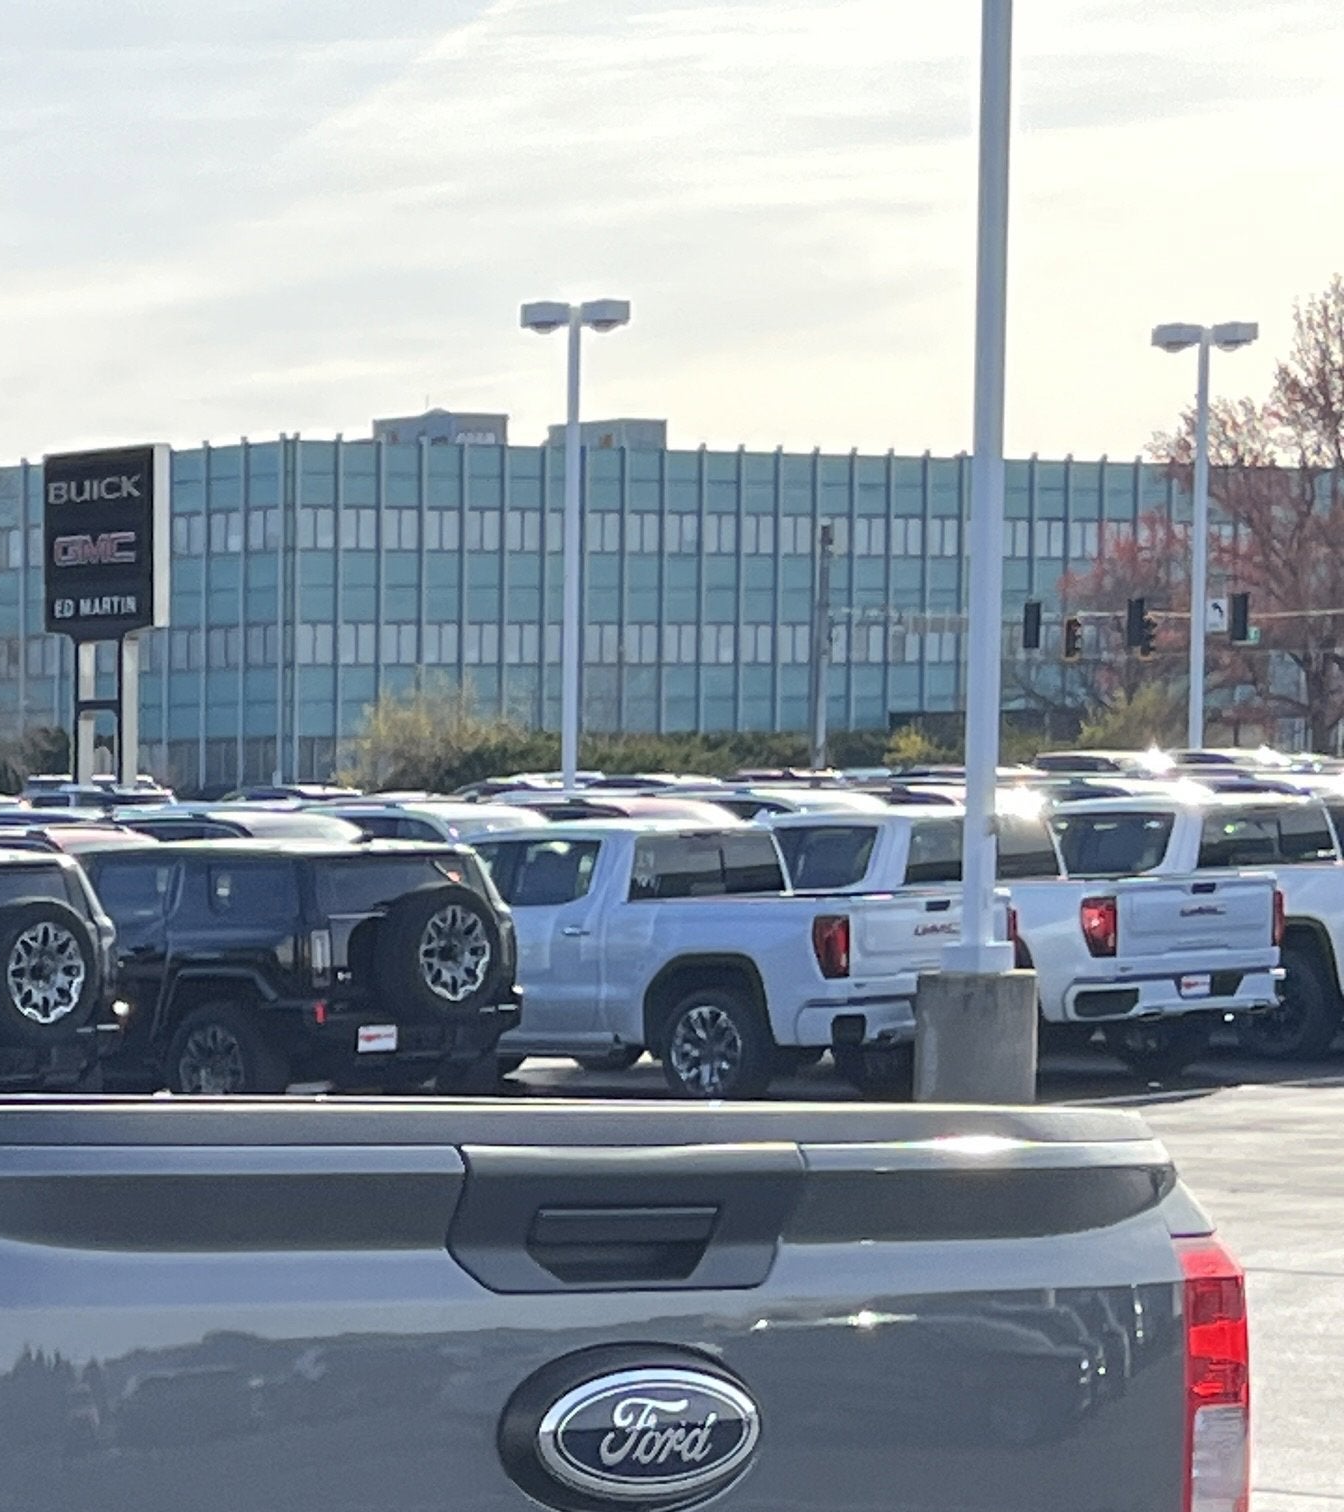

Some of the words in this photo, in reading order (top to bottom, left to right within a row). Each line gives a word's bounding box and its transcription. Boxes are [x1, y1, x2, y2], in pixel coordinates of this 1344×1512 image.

[47, 474, 141, 505] BUICK
[54, 531, 137, 567] GMC
[54, 598, 75, 618] ED
[79, 595, 137, 616] MARTIN
[599, 1397, 718, 1467] Ford
